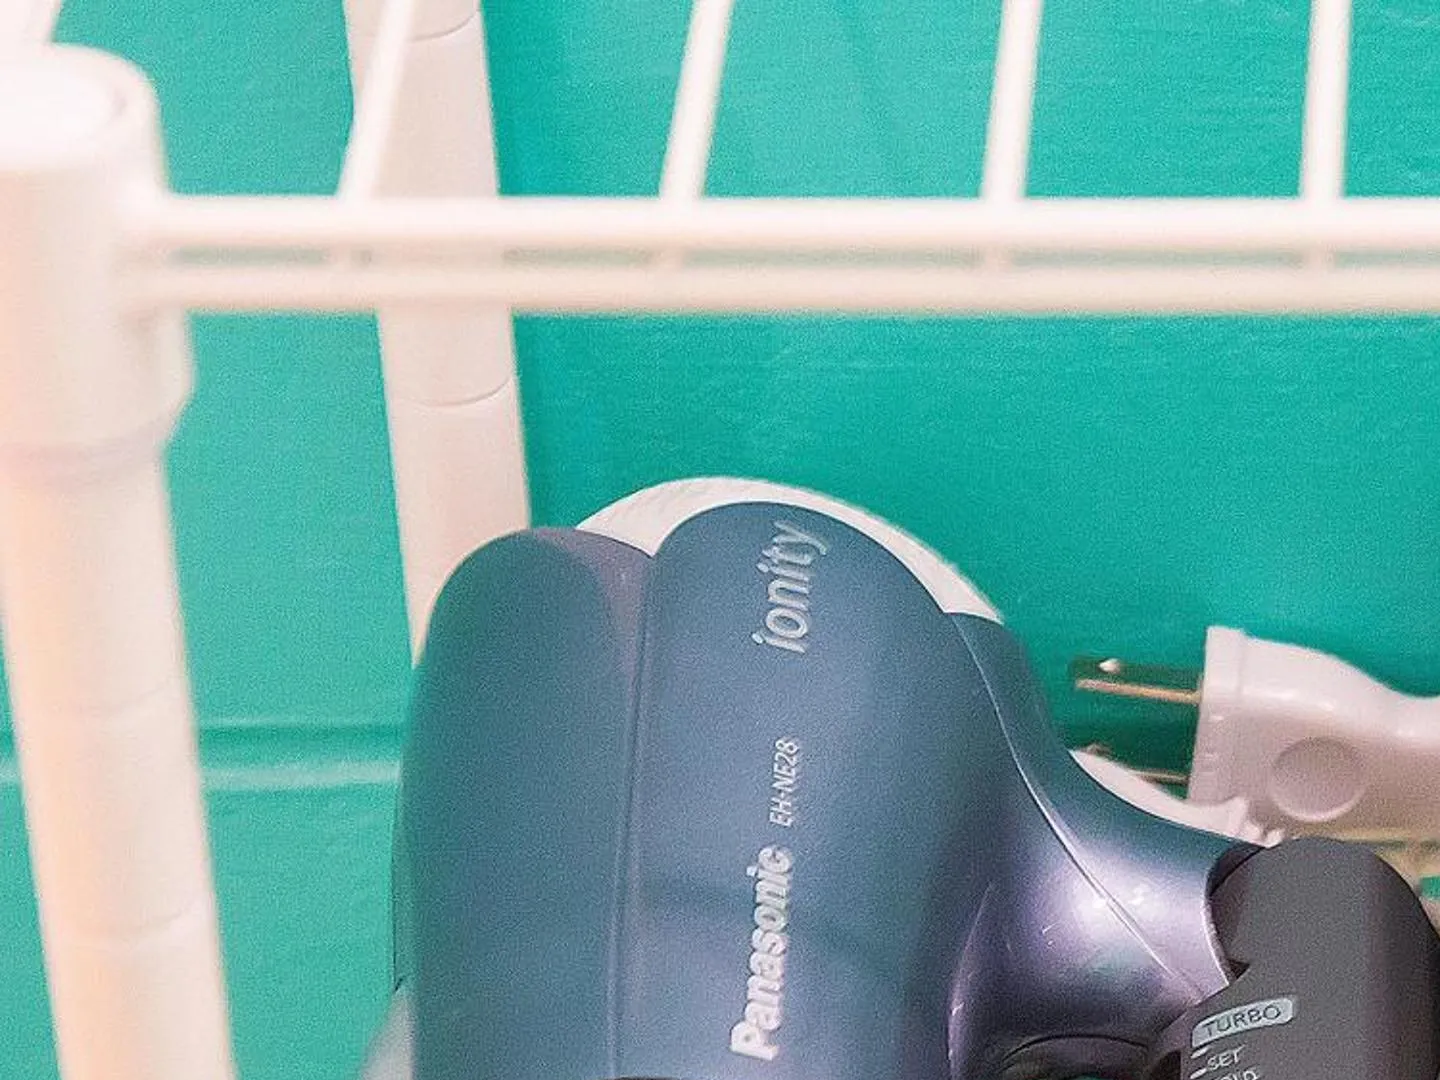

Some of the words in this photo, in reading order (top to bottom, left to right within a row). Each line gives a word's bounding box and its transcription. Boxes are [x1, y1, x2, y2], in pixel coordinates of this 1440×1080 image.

[752, 518, 828, 655] ionity
[729, 845, 795, 1062] Panasonic
[769, 735, 801, 829] EH-NE28
[1202, 1004, 1281, 1037] TURBO
[1207, 1044, 1246, 1072] SET
